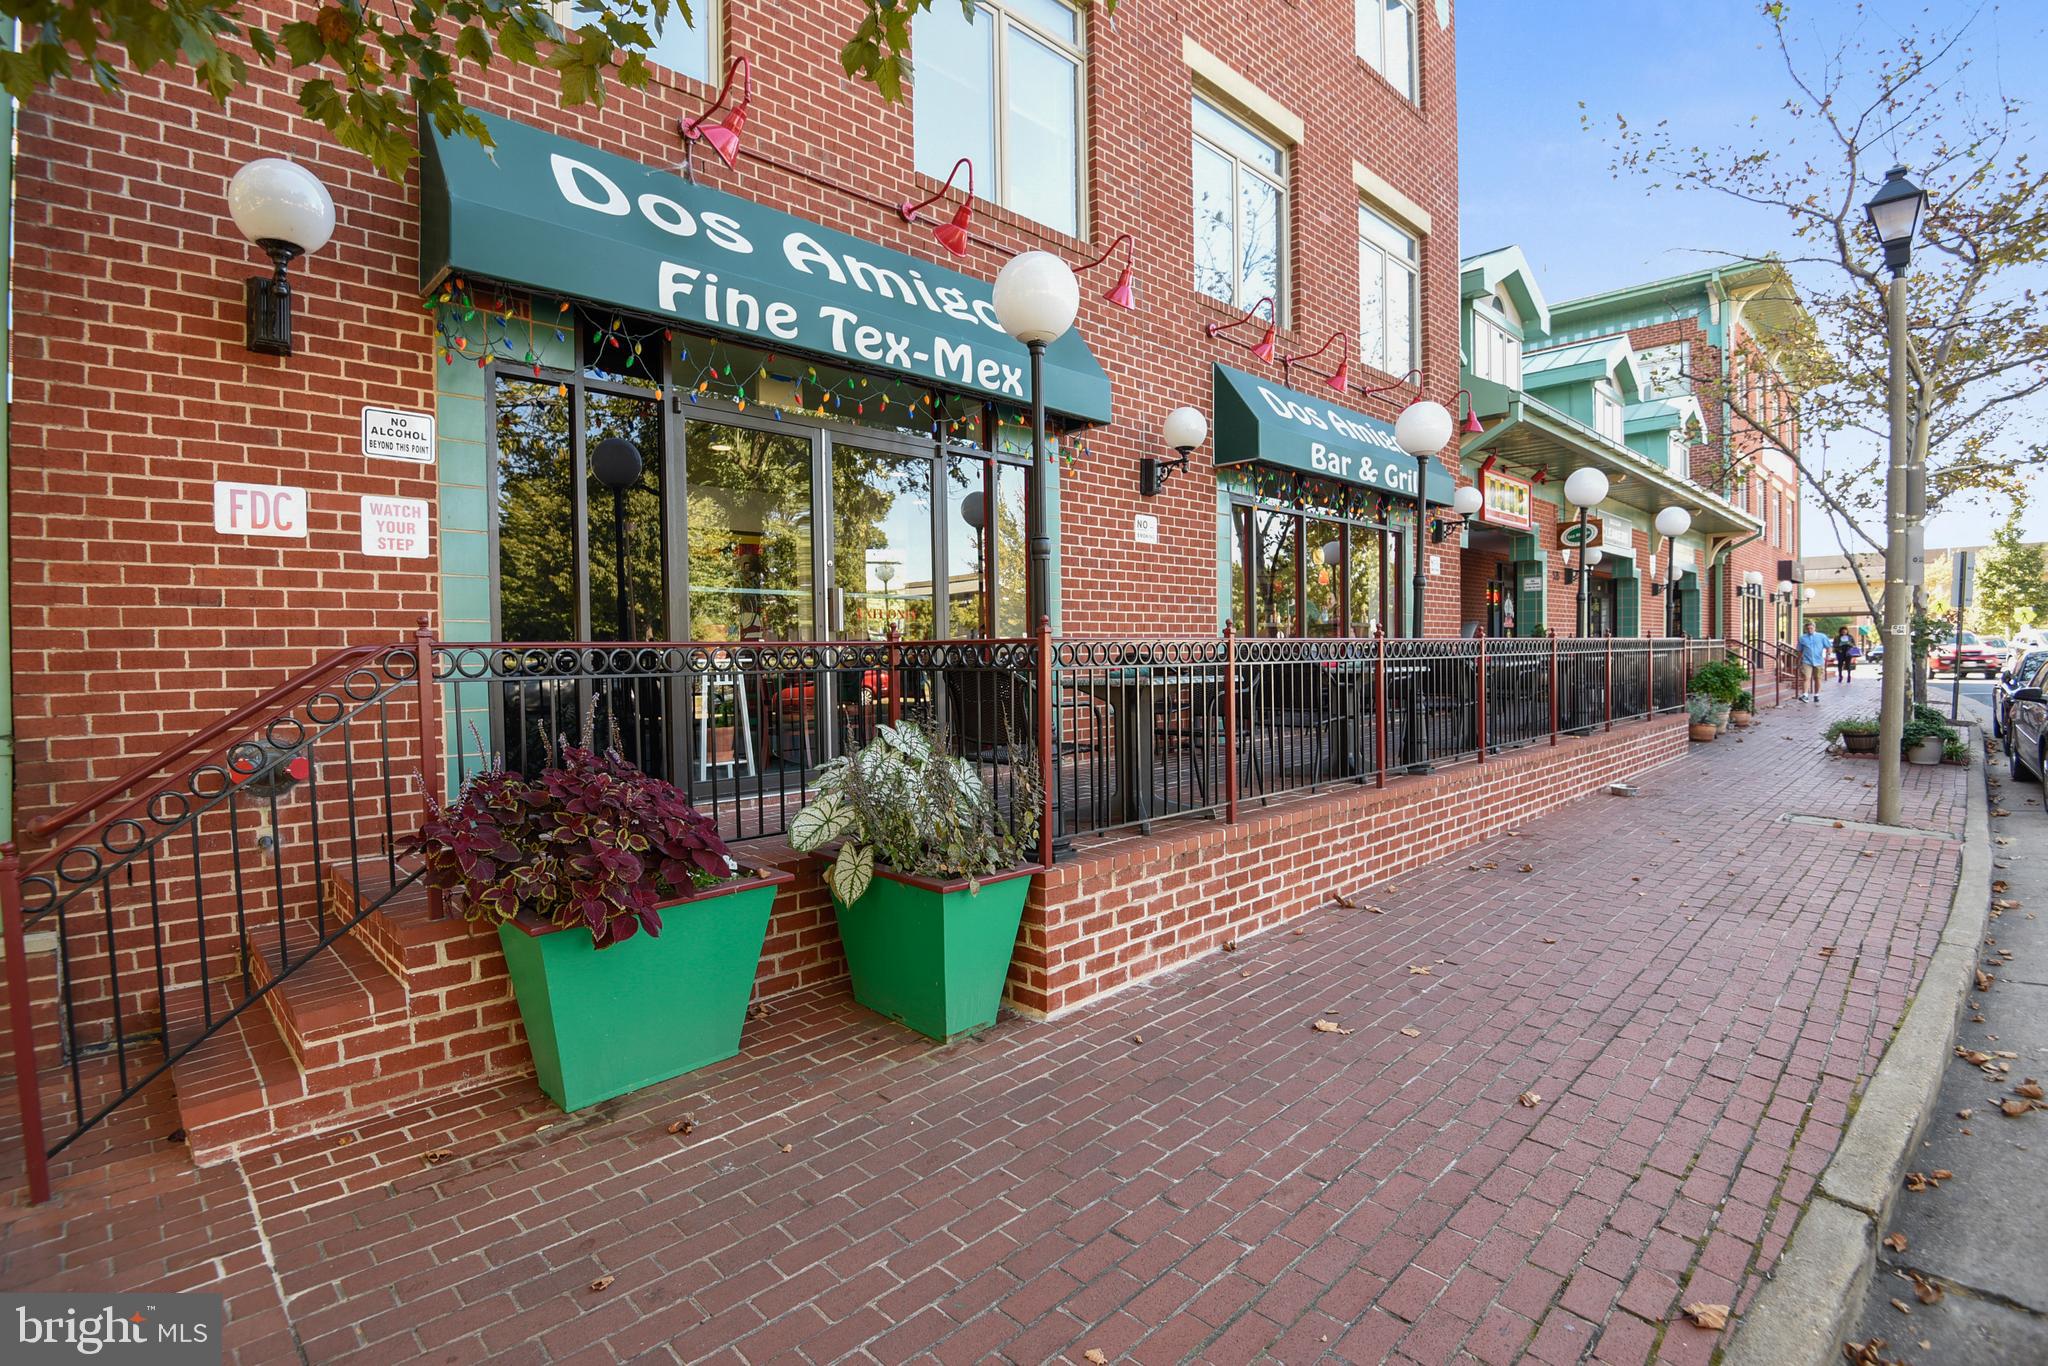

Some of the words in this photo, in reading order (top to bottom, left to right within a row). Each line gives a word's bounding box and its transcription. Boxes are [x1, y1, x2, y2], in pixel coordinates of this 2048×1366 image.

[550, 153, 754, 254] Dos
[782, 232, 1007, 334] Amigo
[658, 261, 799, 340] Fine
[819, 305, 1024, 397] Tex-Mex
[390, 417, 407, 427] NO
[1257, 385, 1329, 431] Dos
[1327, 409, 1411, 457] Amig
[370, 426, 427, 441] ALCOHOL
[369, 439, 394, 451] BEYOND
[395, 442, 410, 453] THIS
[411, 444, 429, 455] POINT
[1311, 442, 1352, 476] Bar
[1358, 456, 1379, 483] &
[1384, 463, 1418, 494] Gril
[229, 488, 293, 532] FDC
[369, 502, 422, 519] WATCH
[376, 519, 416, 535] YOUR
[1136, 519, 1149, 530] NO
[377, 536, 415, 551] STEP
